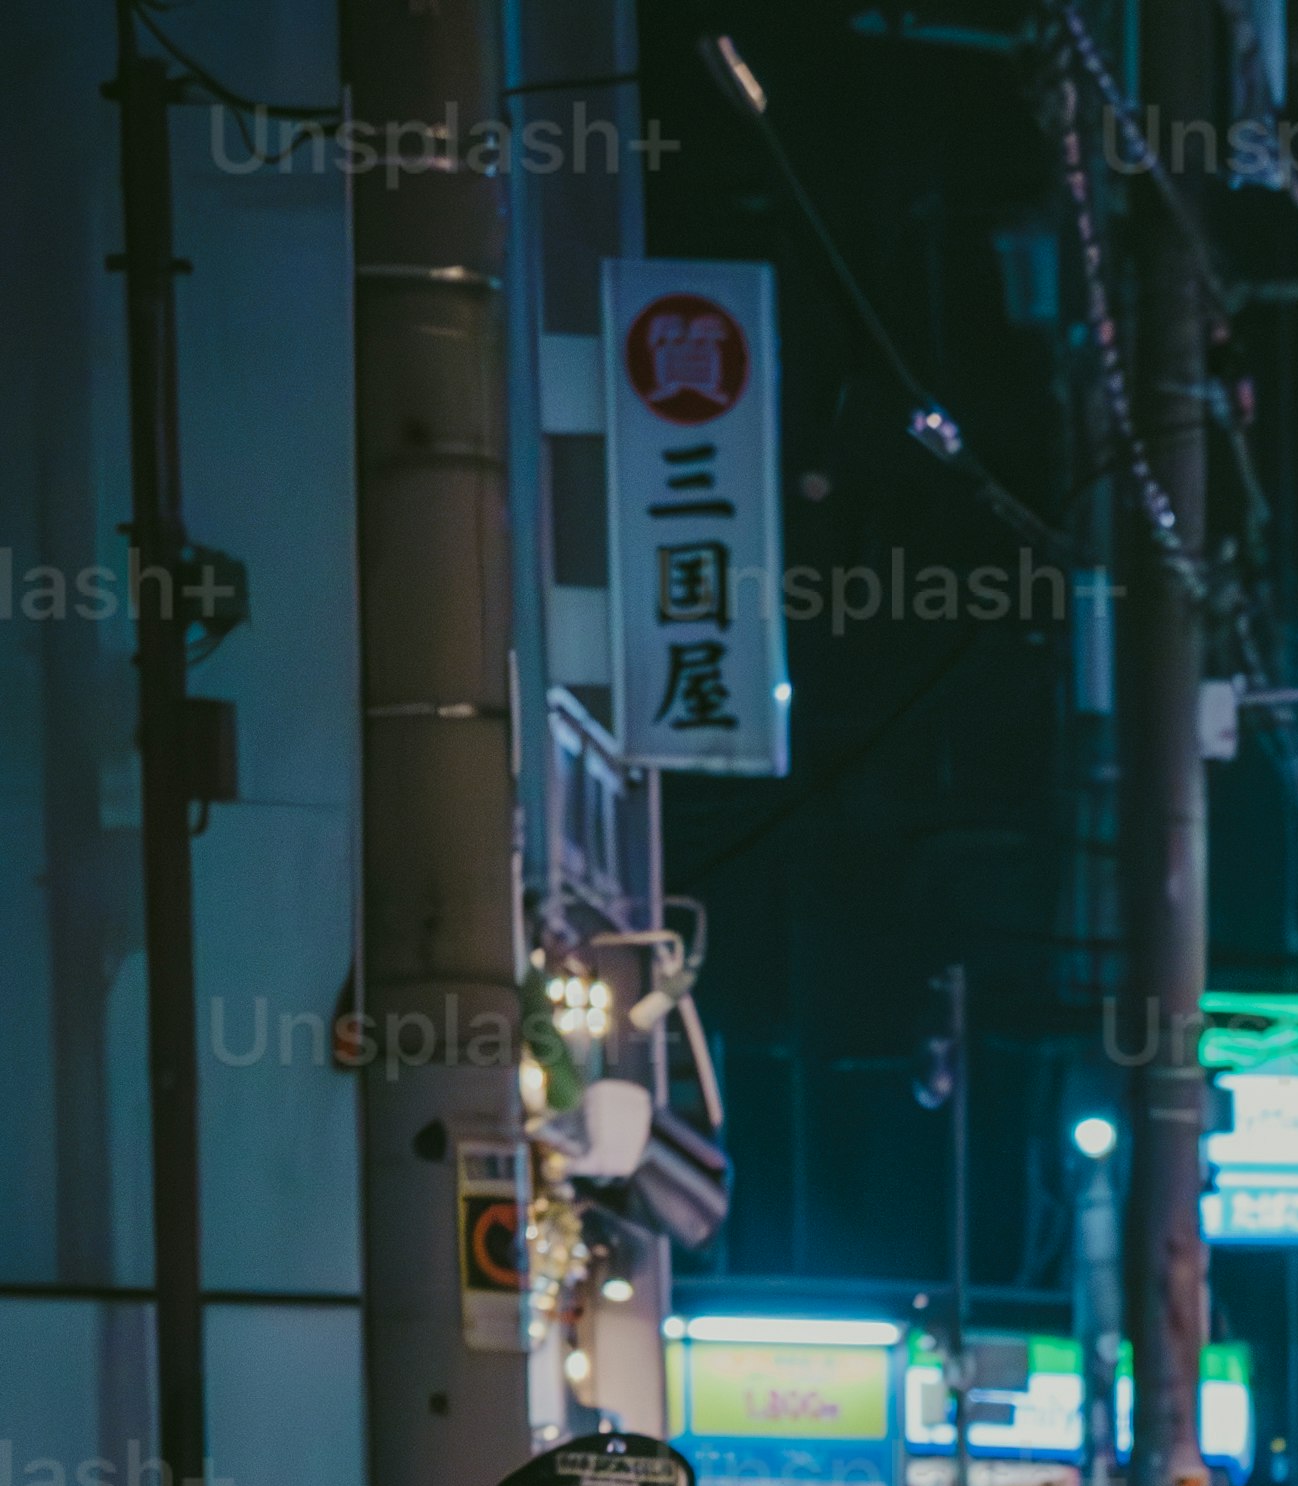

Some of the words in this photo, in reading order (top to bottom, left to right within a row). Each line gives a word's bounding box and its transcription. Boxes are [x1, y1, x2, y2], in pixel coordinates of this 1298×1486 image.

[646, 313, 731, 406] 質
[647, 442, 739, 733] 三国屋
